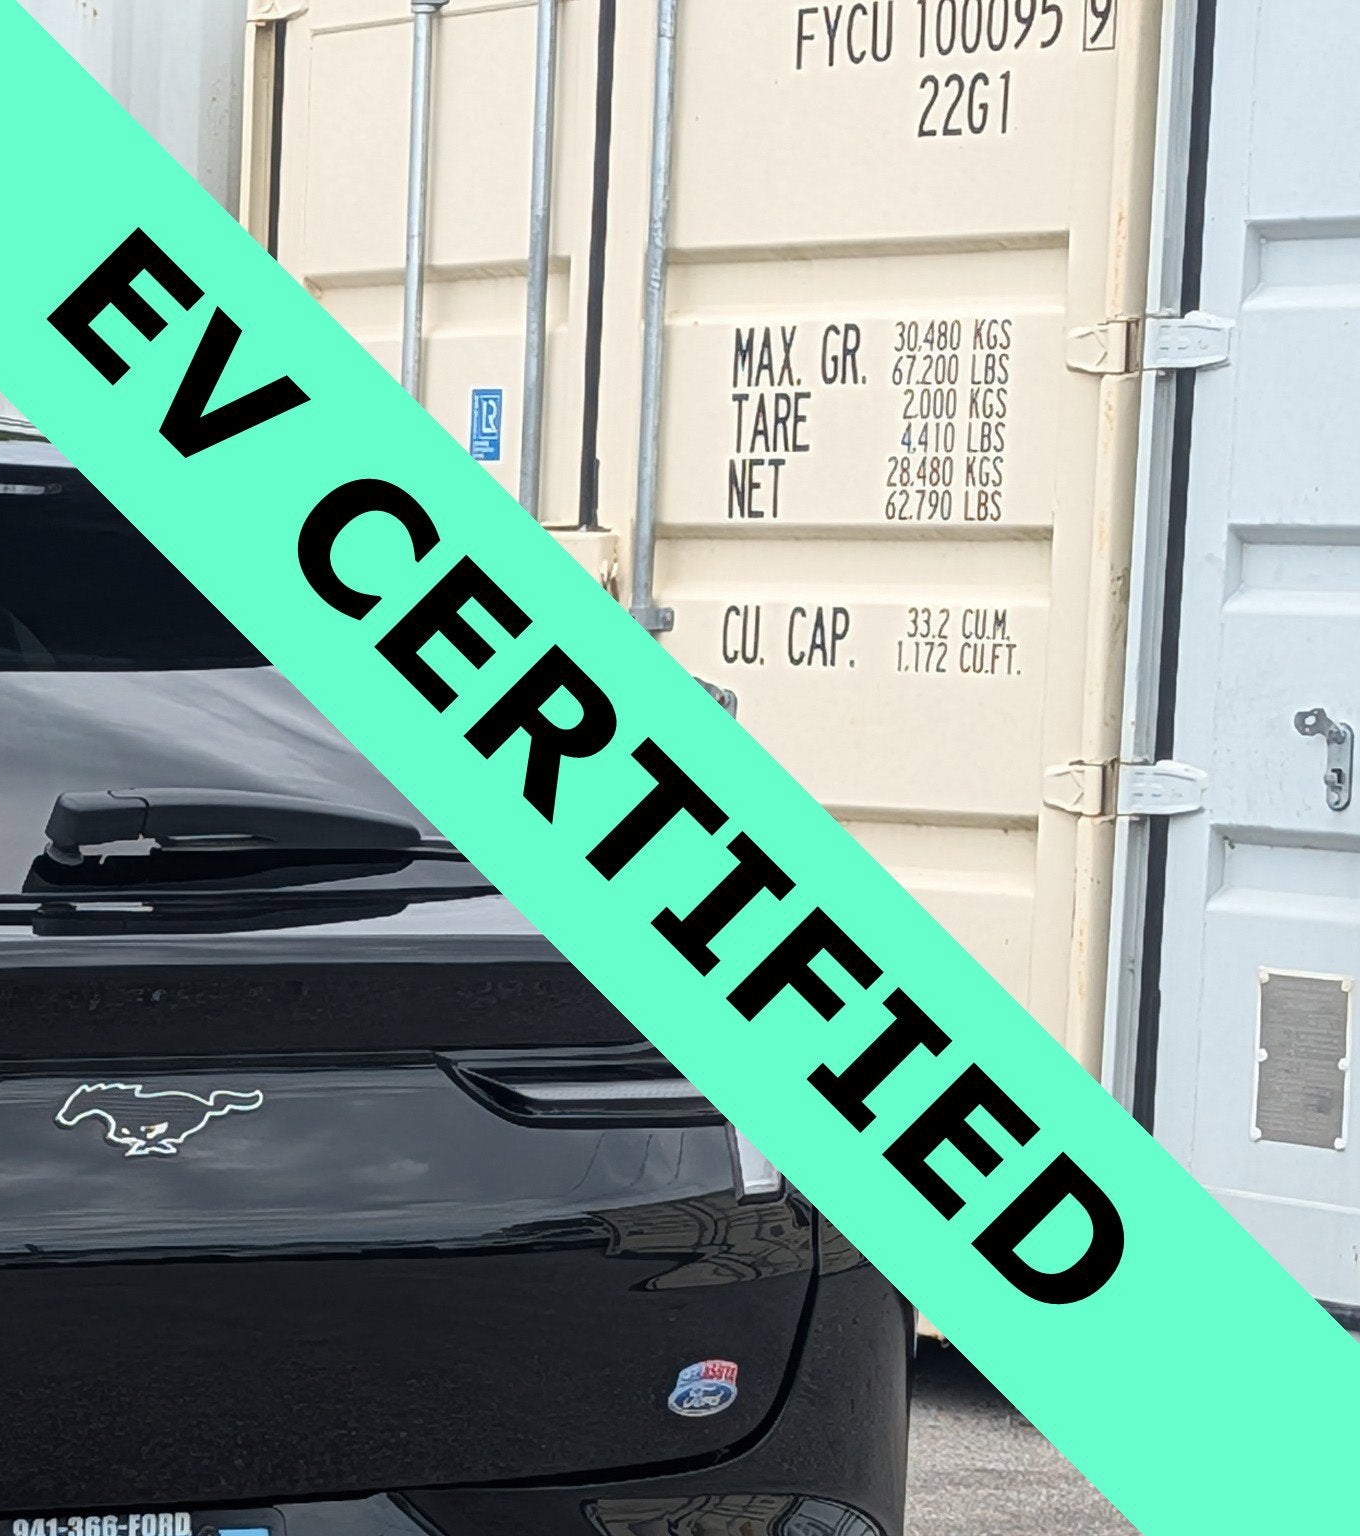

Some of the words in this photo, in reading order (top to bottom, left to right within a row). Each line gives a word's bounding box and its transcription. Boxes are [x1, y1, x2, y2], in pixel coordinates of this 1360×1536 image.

[795, 1, 893, 70] FYCU
[917, 0, 1063, 58] 100095
[917, 71, 1011, 138] 22G1
[972, 318, 1012, 350] KGS
[733, 326, 802, 388] MAX.
[820, 323, 867, 385] GR.
[970, 353, 1009, 385] LBS
[968, 387, 1008, 419] KGS
[732, 391, 811, 453] TARE
[966, 421, 1006, 453] LBS
[727, 458, 786, 519] NET
[964, 455, 1004, 488] KGS
[963, 489, 1002, 522] LBS
[722, 605, 765, 666] CU.
[787, 606, 856, 668] CAP.
[906, 607, 951, 640] 33.2
[959, 641, 1022, 676] CU.FT.
